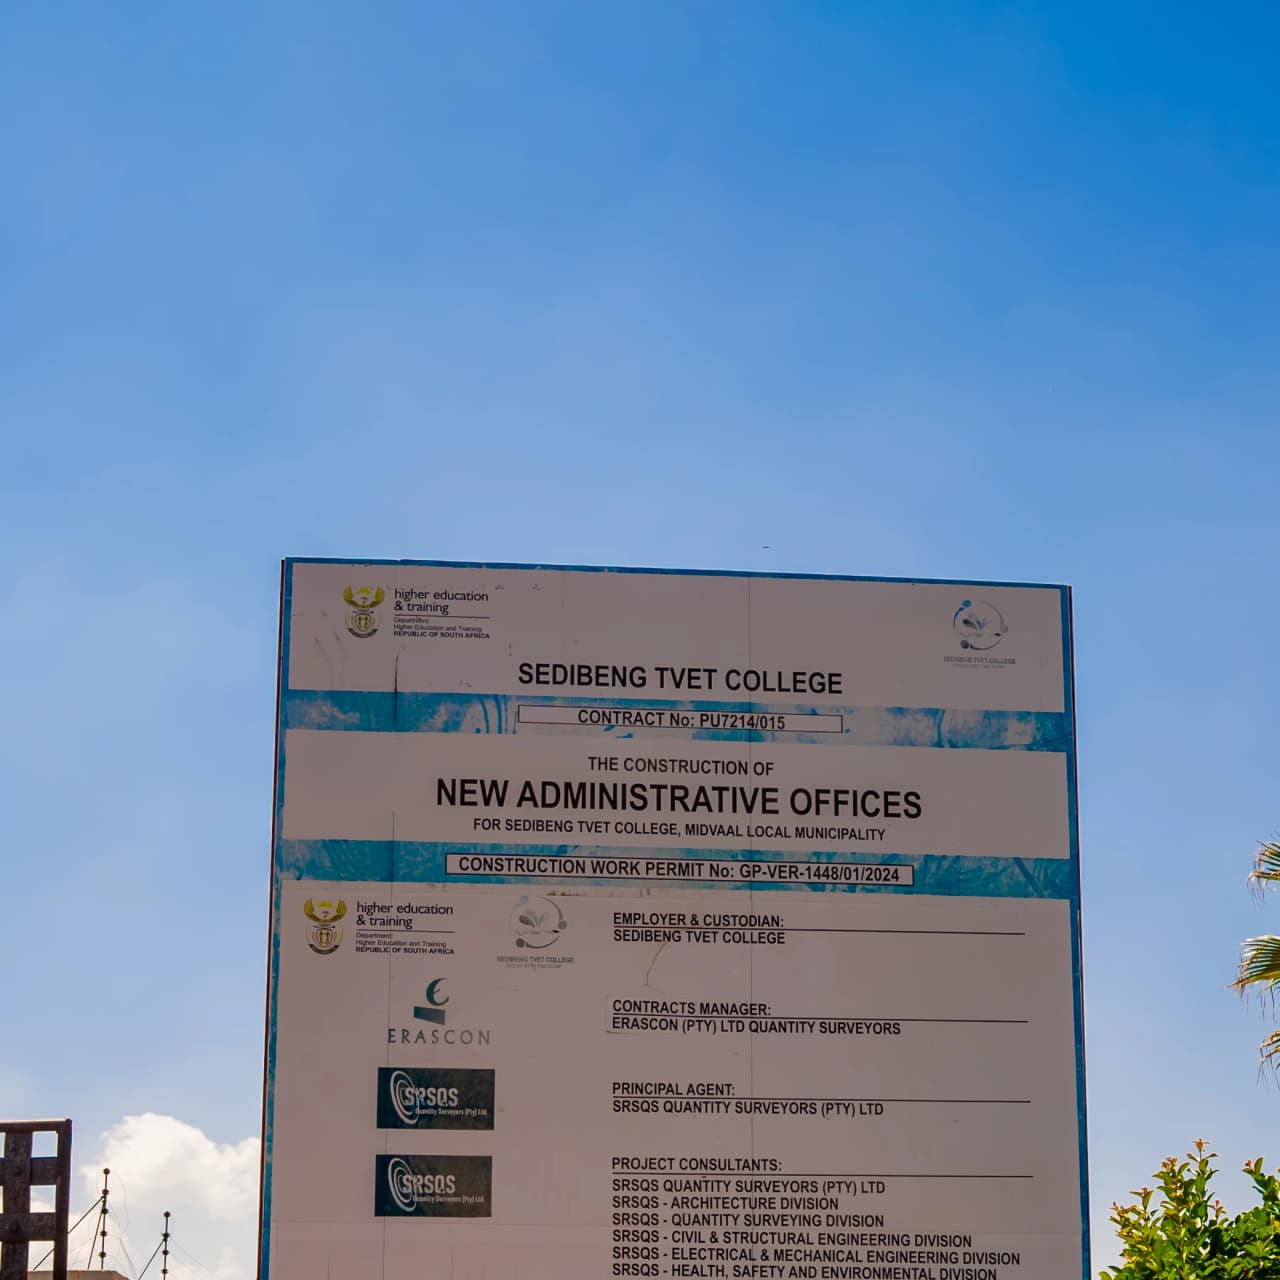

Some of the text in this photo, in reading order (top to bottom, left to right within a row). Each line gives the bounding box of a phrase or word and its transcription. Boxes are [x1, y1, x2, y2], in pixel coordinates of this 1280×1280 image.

[394, 588, 488, 602] higher education
[394, 601, 448, 615] & training
[518, 663, 842, 694] SEDIBENG TVET COLLEGE
[578, 710, 785, 730] CONTRACT No: PU7214/015
[588, 757, 774, 776] THE CONSTRUCTION OF
[437, 778, 922, 818] NEW ADMINISTRATIVE OFFICES
[474, 818, 885, 840] FOR SEDIBENG TVET COLLEGE, MIDVAAL LOCAL MUNICIPALITY
[459, 857, 900, 882] CONSTRUCTION WORK PERMIT No: GP-VER-1448/01/2024
[357, 902, 453, 916] higher education
[356, 914, 413, 930] & training
[614, 912, 784, 927] EMPLOYER & CUSTODIAN:
[356, 939, 375, 947] Higher
[614, 929, 785, 944] SEDIBENG TVET COLLEGE
[613, 1000, 771, 1016] CONTRACTS MANAGER:
[612, 1017, 900, 1035] ERASCON (PTY) LTD QUANTITY SURVEYORS
[388, 1028, 489, 1044] ERASCON
[404, 1088, 459, 1107] SRSQS
[613, 1082, 734, 1096] PRINCIPAL AGENT:
[613, 1100, 884, 1118] SRSQS QUANTITY SURVEYORS (PTY) LTD
[612, 1157, 782, 1171] PROJECT CONSULTANTS:
[402, 1175, 456, 1194] SRSQS
[612, 1179, 885, 1196] SRSQS QUANTITY SURVEYORS (PTY) LTD
[612, 1196, 659, 1209] SRSQS
[671, 1197, 776, 1210] ARCHITECTURE
[780, 1197, 838, 1210] DIVISION
[612, 1213, 659, 1226] SRSQS
[672, 1214, 740, 1227] QUANTITY
[744, 1214, 822, 1227] SURVEYING
[826, 1214, 884, 1227] DIVISION
[613, 1230, 659, 1243] SRSQS
[672, 1230, 706, 1243] CIVIL
[710, 1231, 719, 1243] &
[723, 1232, 814, 1245] STRUCTURAL
[818, 1233, 910, 1246] ENGINEERING
[915, 1234, 972, 1248] DIVISION
[612, 1246, 659, 1260] SRSQS
[672, 1248, 757, 1261] ELECTRICAL
[760, 1249, 770, 1261] &
[774, 1249, 863, 1262] MECHANICAL
[867, 1250, 958, 1264] ENGINEERING
[963, 1252, 1020, 1265] DIVISION
[612, 1263, 659, 1277] SRSQS
[672, 1264, 728, 1279] HEALTH,
[733, 1265, 785, 1278] SAFETY
[788, 1266, 817, 1278] AND
[822, 1266, 936, 1280] ENVIRONMENTAL
[940, 1268, 996, 1280] DIVISION
